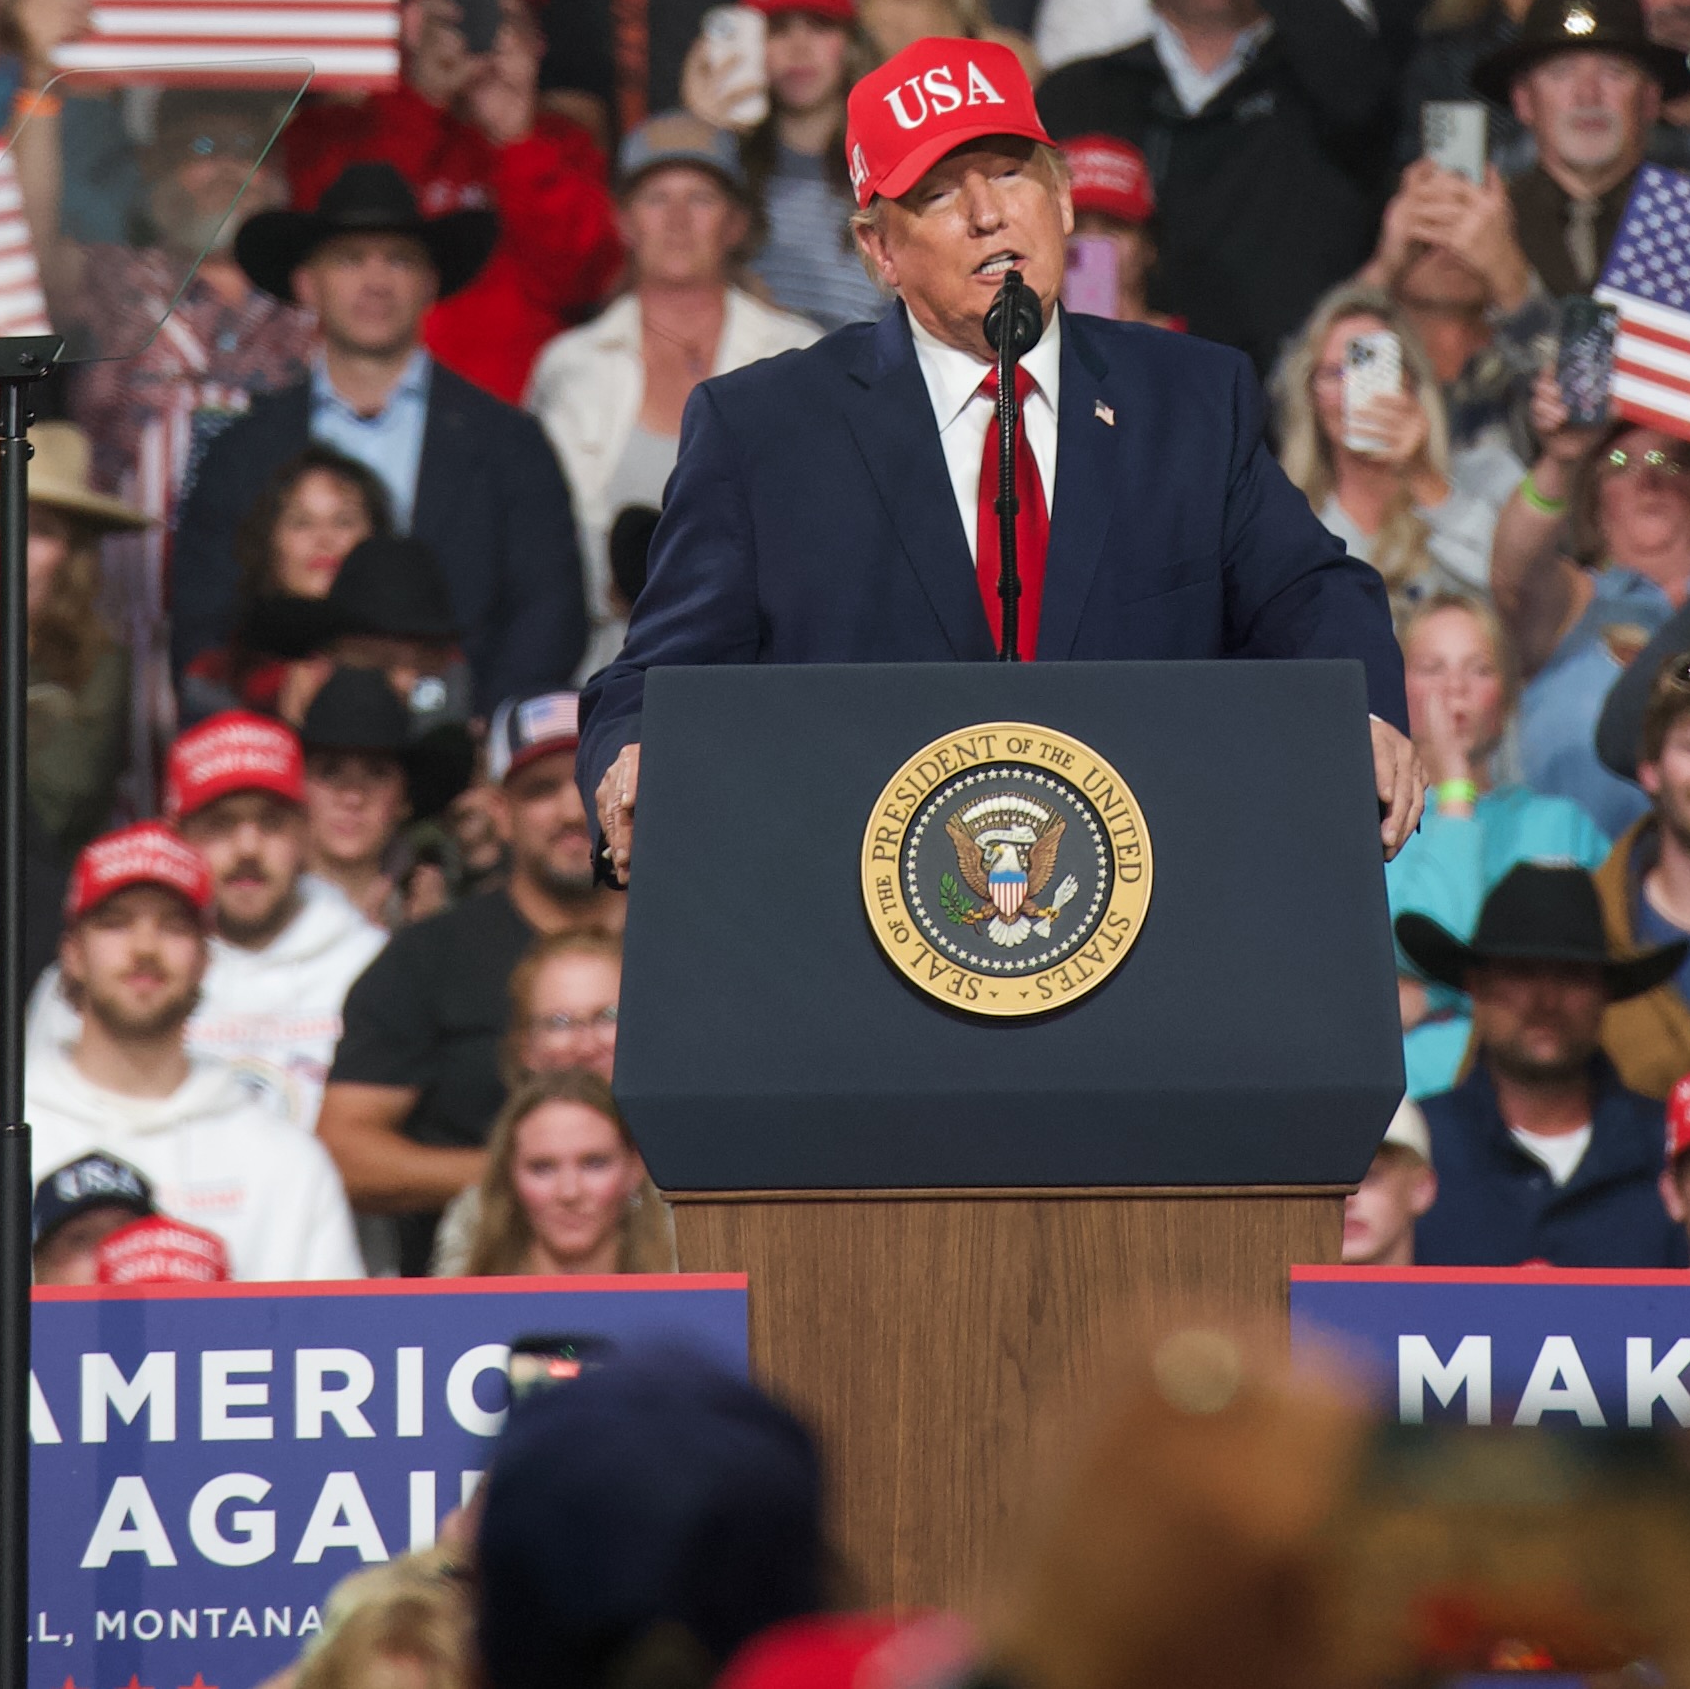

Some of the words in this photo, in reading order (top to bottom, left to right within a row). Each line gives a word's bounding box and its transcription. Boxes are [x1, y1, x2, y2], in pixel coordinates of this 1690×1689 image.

[883, 60, 1006, 130] USA
[1006, 737, 1033, 754] OF
[1039, 742, 1076, 770] THE
[872, 734, 997, 864] PRESIDENT
[1082, 766, 1142, 884] UNITED
[876, 874, 898, 915] THE
[887, 919, 910, 945] OF
[1035, 909, 1130, 1000] STATES
[910, 941, 983, 1000] SEAL
[79, 1469, 485, 1569] AGAI
[95, 1606, 324, 1642] MONTANA
